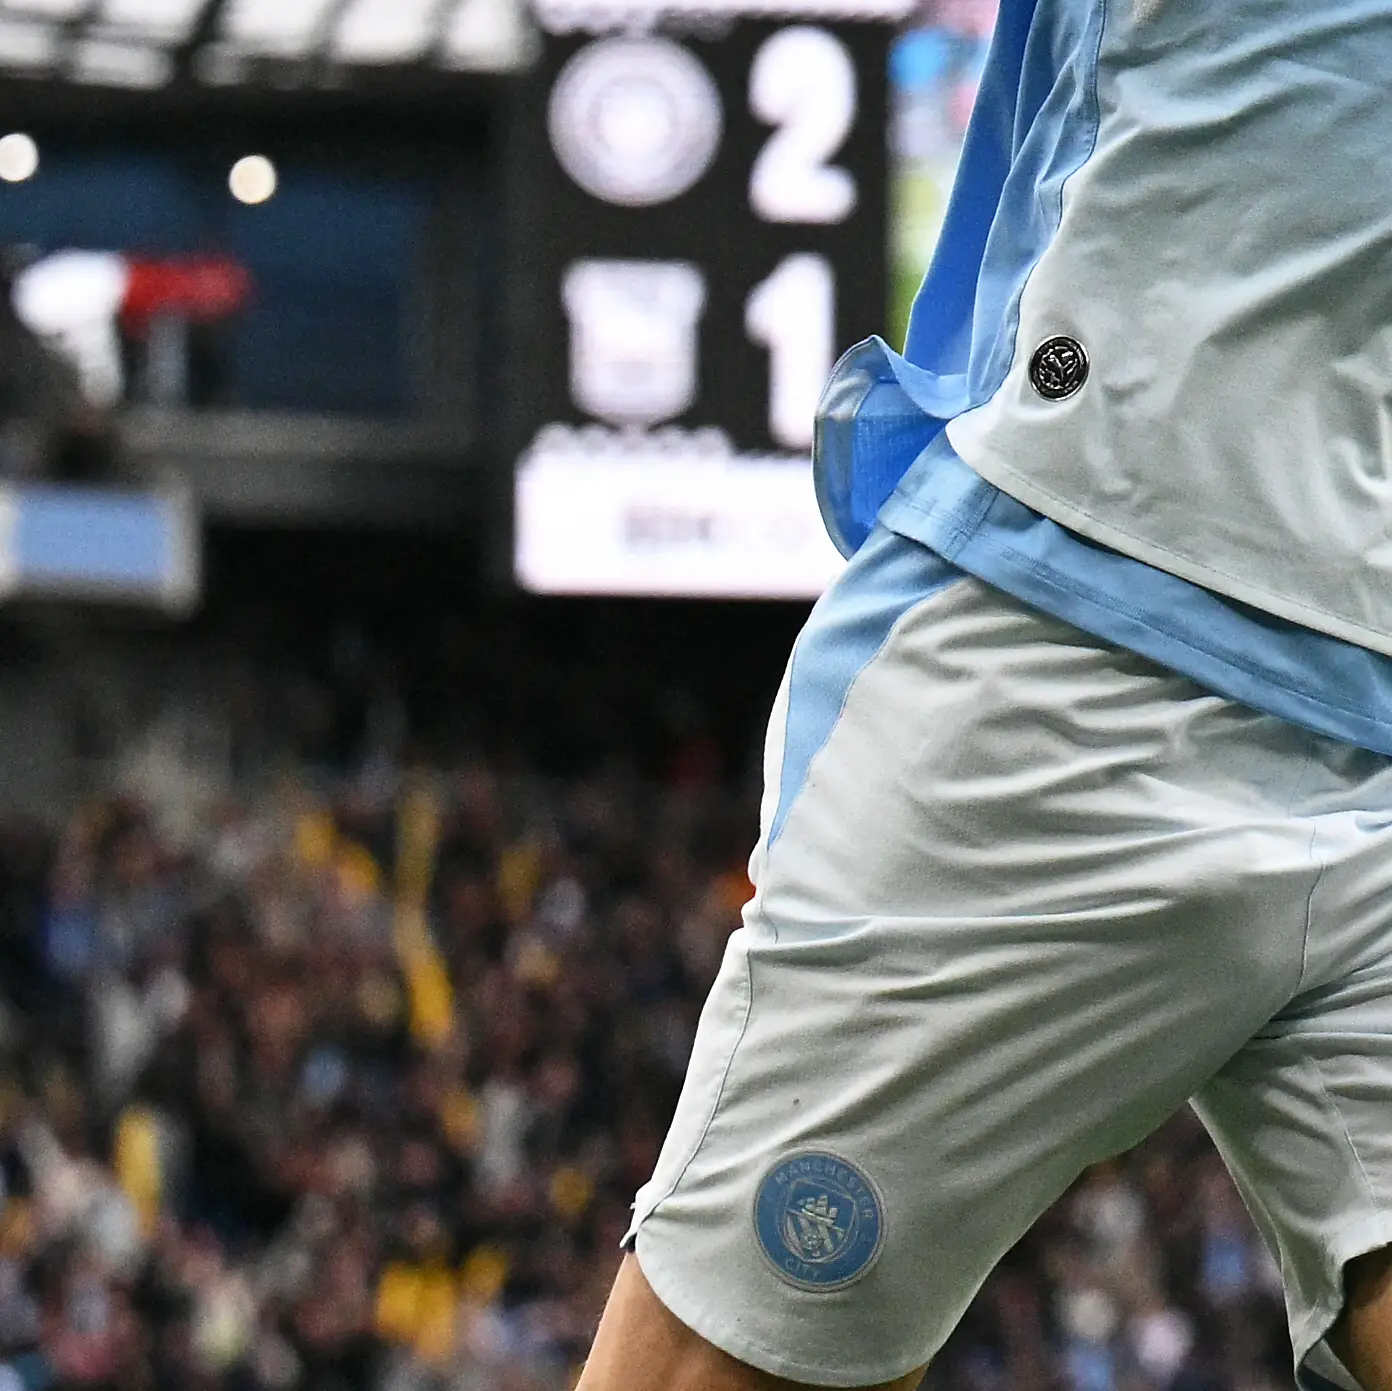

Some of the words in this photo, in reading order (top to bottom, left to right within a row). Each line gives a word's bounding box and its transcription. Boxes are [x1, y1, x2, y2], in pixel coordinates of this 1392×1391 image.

[749, 26, 858, 222] 2
[745, 255, 835, 448] 1
[774, 1160, 874, 1220] MANCHESTER
[784, 1256, 821, 1281] CITY
